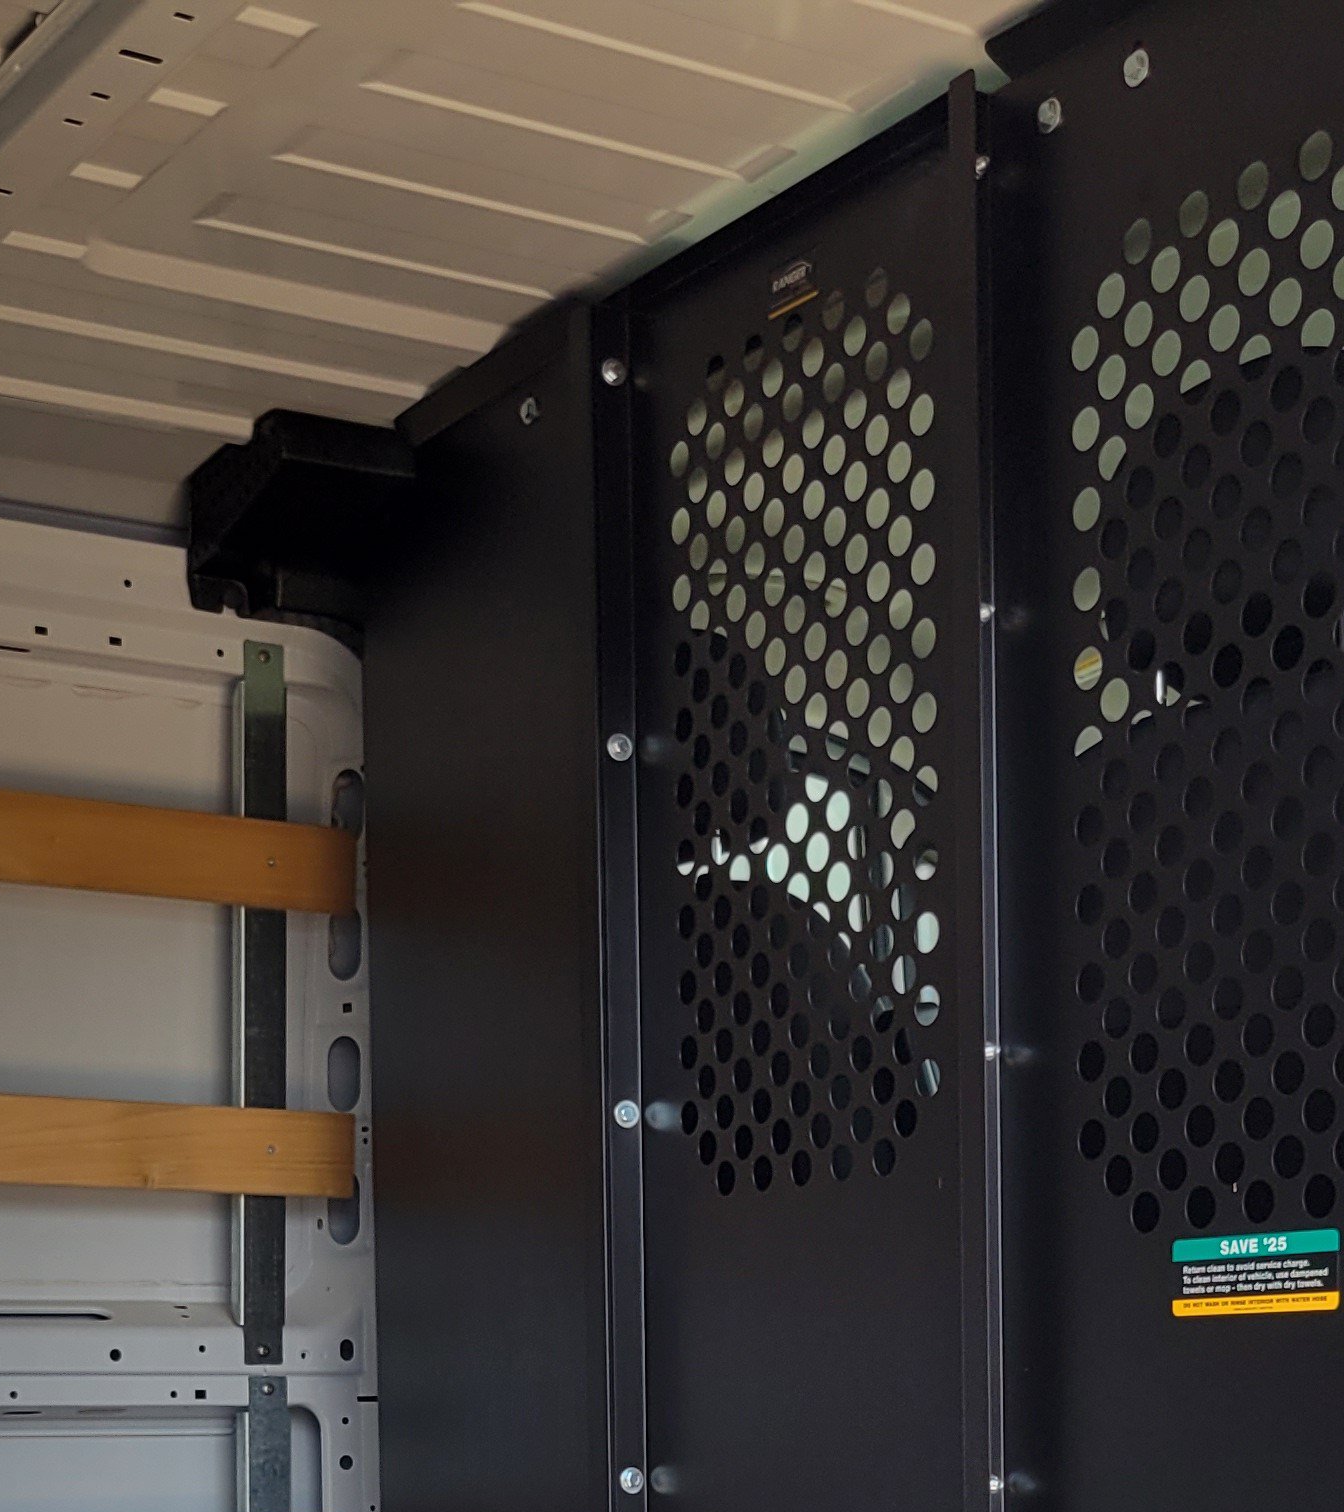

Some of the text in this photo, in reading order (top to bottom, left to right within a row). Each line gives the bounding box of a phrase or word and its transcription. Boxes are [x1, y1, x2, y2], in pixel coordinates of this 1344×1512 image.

[1220, 1236, 1287, 1256] SAVE $25
[1182, 1259, 1311, 1275] Return clean to avoid service charge.
[1182, 1267, 1329, 1285] To clean interior of vehicle, use dampened
[1182, 1285, 1205, 1295] towels
[1215, 1285, 1231, 1295] mop
[1236, 1282, 1253, 1292] then
[1253, 1281, 1266, 1292] dry
[1267, 1280, 1283, 1290] with
[1283, 1280, 1296, 1290] dry
[1296, 1279, 1324, 1288] towels.
